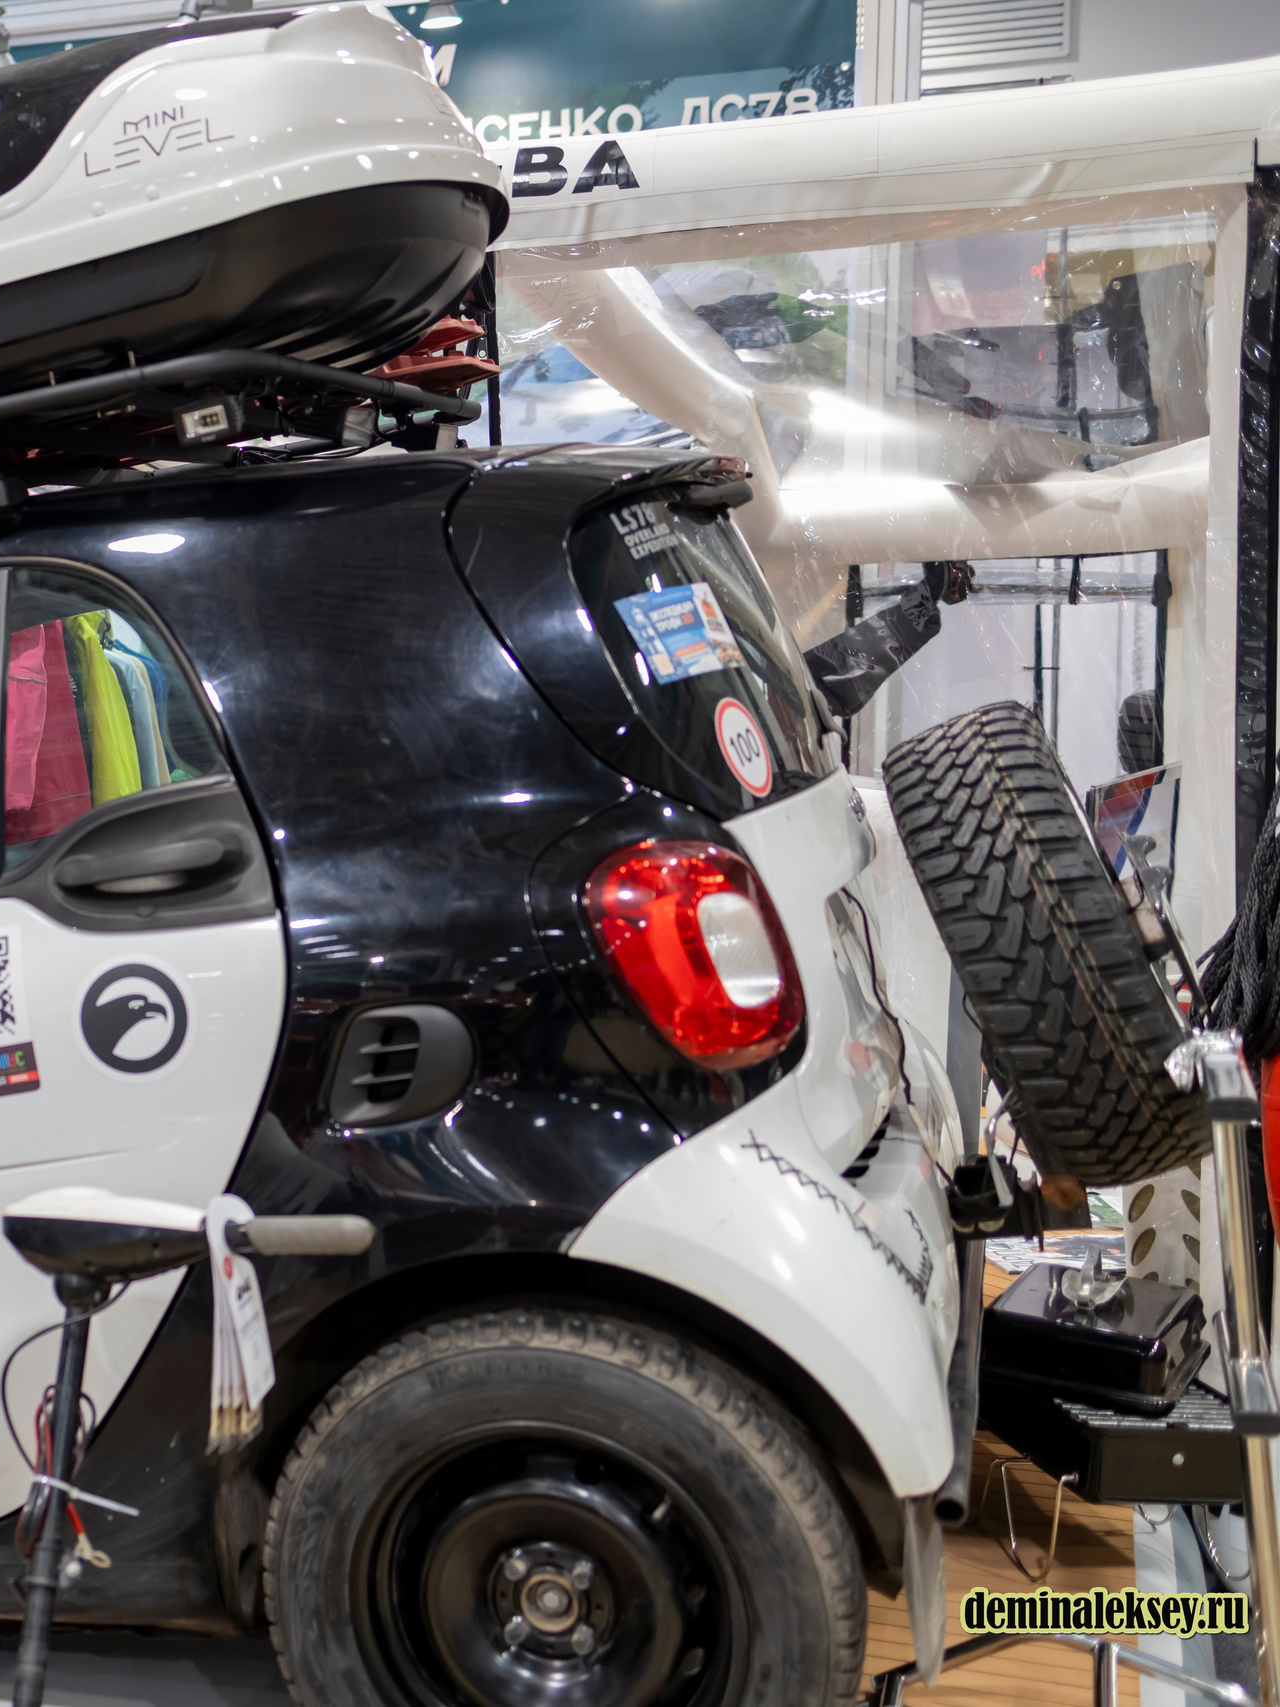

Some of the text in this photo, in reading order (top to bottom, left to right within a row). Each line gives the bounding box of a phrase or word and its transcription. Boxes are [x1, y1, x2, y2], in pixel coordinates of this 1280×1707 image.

[123, 105, 184, 135] MINI
[465, 104, 643, 141] СЕНКО
[83, 117, 235, 177] LEVEL
[730, 727, 760, 767] 100
